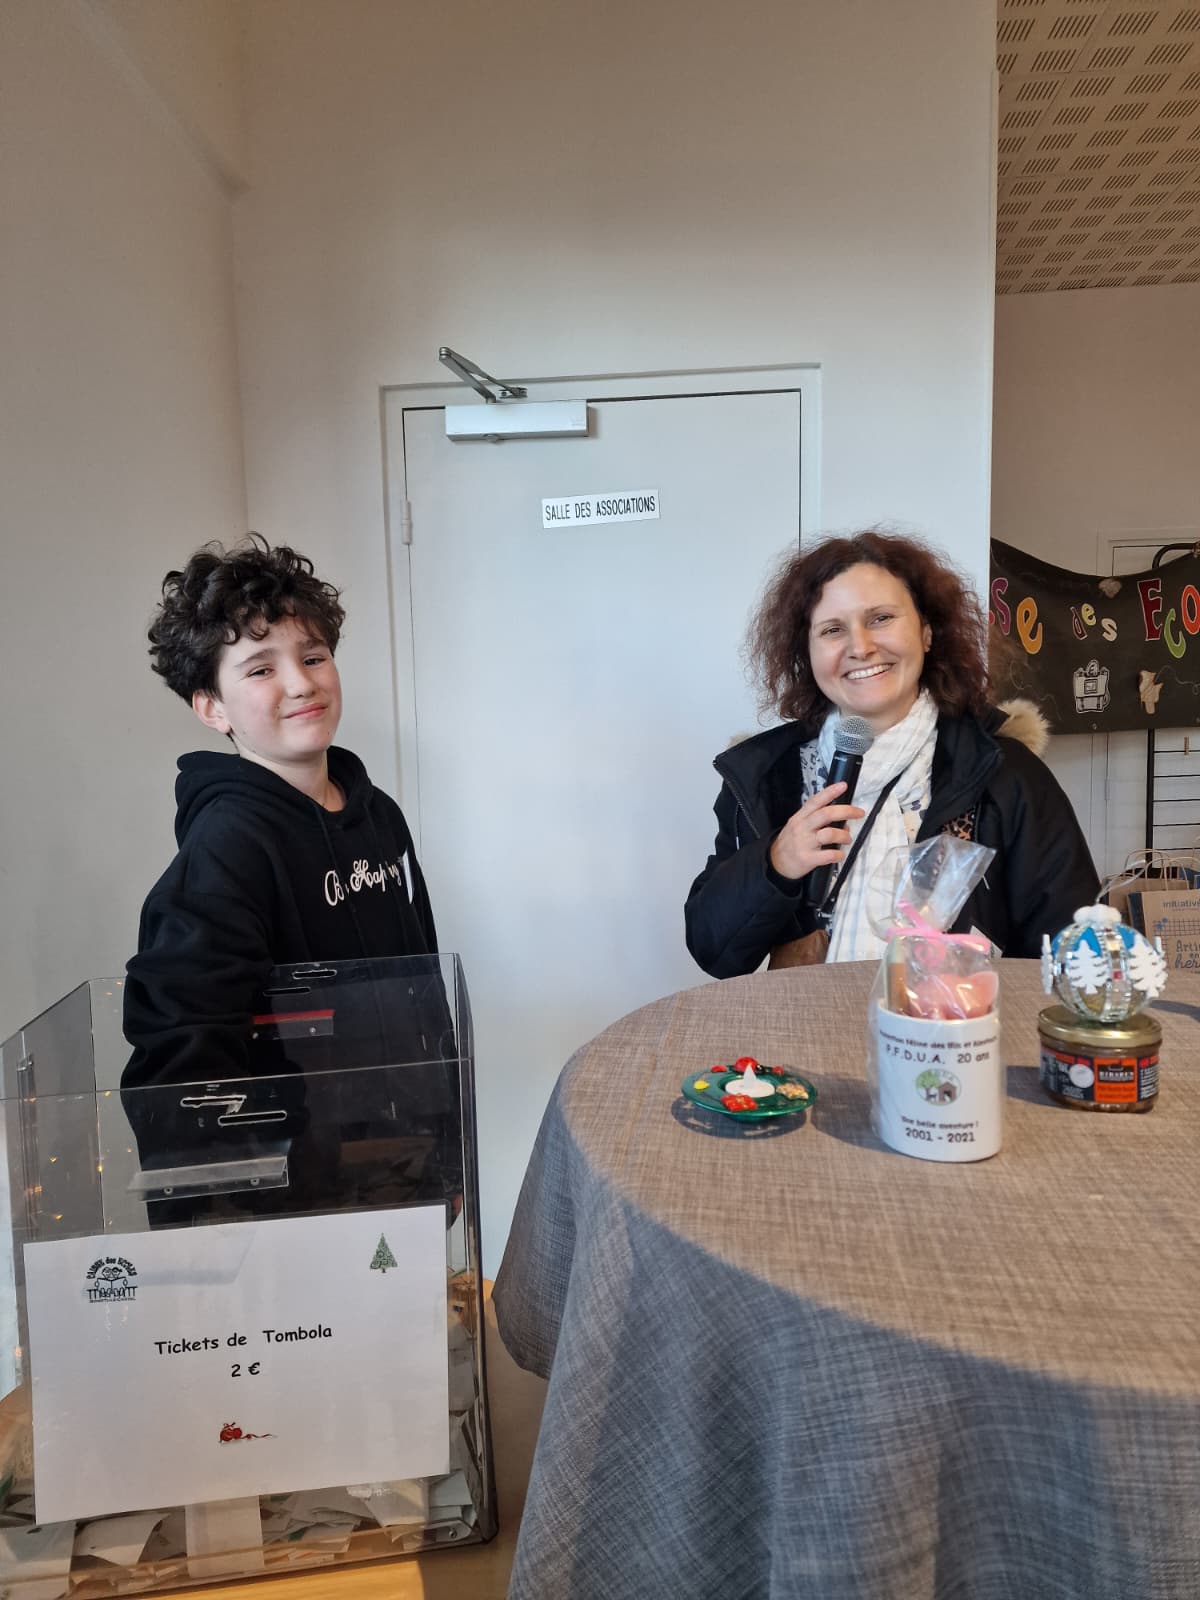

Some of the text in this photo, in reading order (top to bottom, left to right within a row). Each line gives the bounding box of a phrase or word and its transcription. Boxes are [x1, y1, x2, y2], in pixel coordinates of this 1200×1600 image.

[545, 495, 655, 521] SALLE DES ASSOCIATIONS
[957, 1052, 971, 1063] 20
[975, 1052, 990, 1062] ans
[905, 1127, 933, 1142] 2001
[947, 1131, 976, 1143] 2021
[154, 1324, 333, 1356] Tickets de Tombola
[230, 1362, 261, 1378] 2 €
